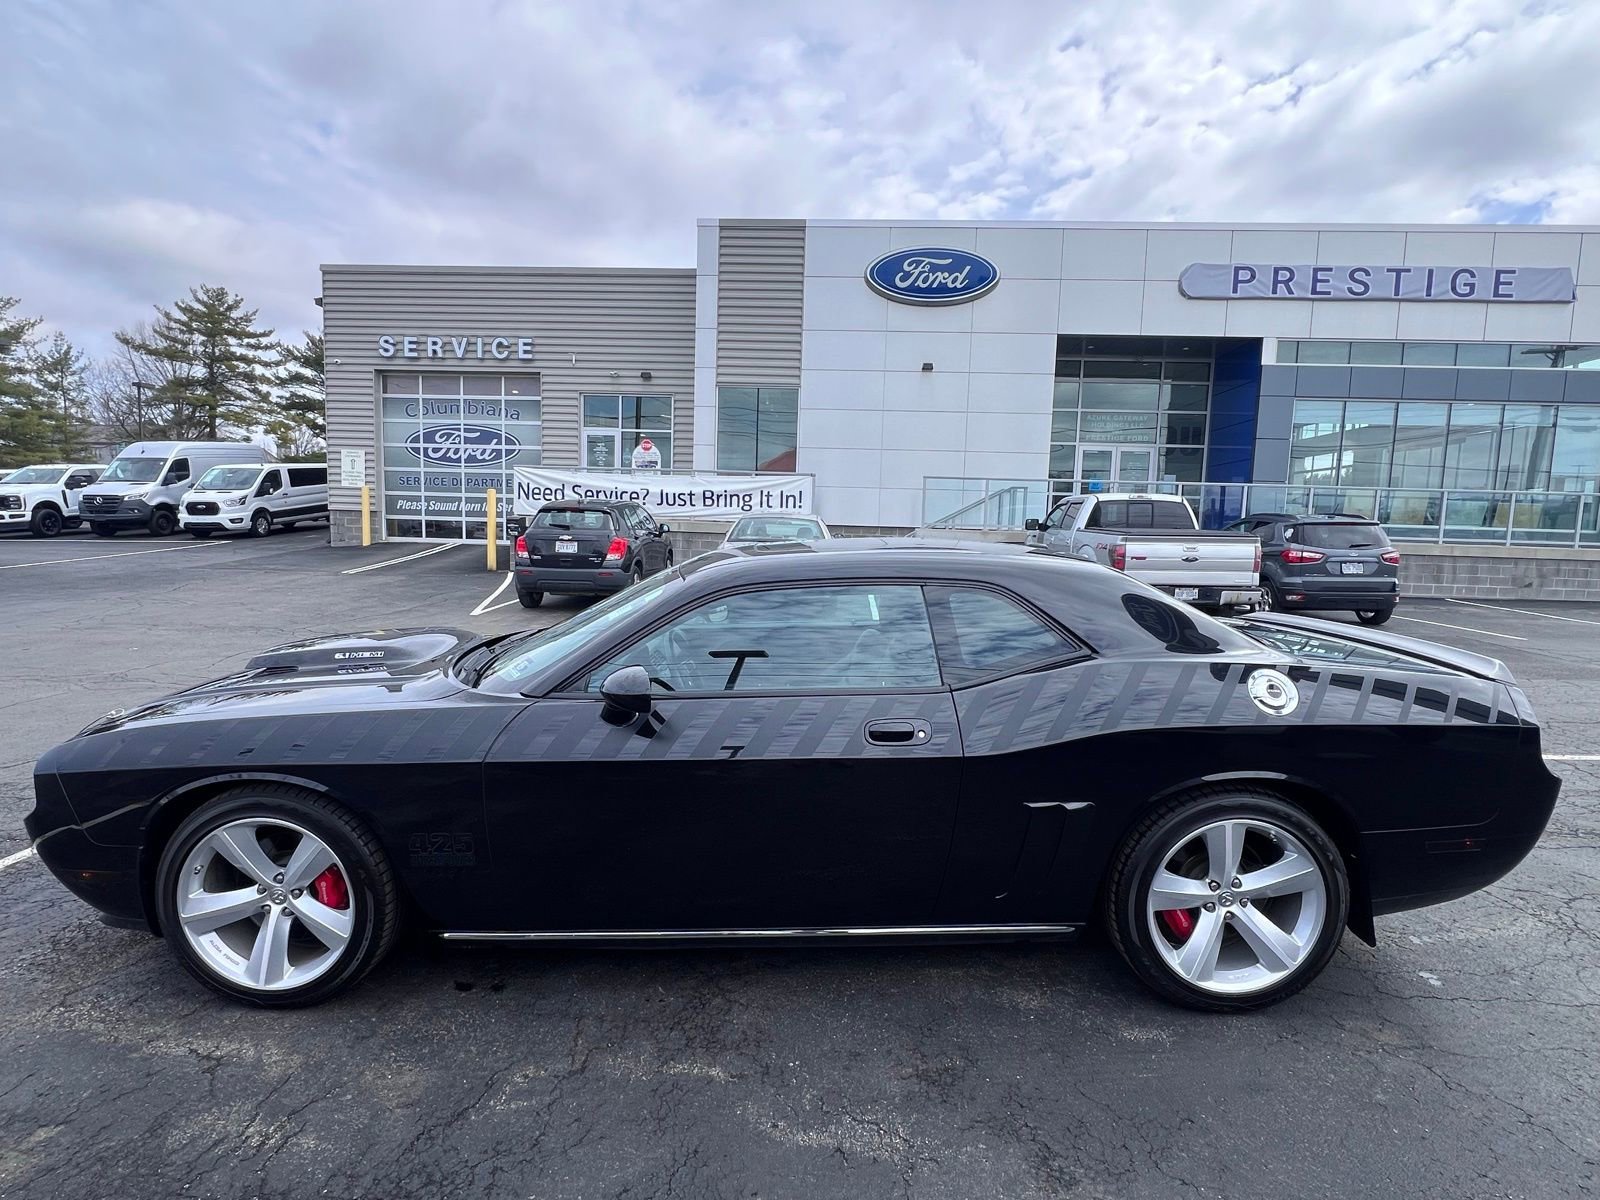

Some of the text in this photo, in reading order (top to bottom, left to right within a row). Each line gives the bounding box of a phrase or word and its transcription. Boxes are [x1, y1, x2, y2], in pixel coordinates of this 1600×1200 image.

[894, 257, 972, 289] Ford
[1231, 265, 1518, 299] PRESTIGE
[378, 335, 533, 360] SERVICE
[405, 400, 520, 420] Columbiana
[427, 429, 498, 460] Ford
[452, 477, 513, 488] DPARTME
[397, 500, 427, 510] Please
[428, 501, 458, 511] Sound
[517, 481, 803, 512] Need Service? Just Bring It In!
[409, 833, 475, 854] 425
